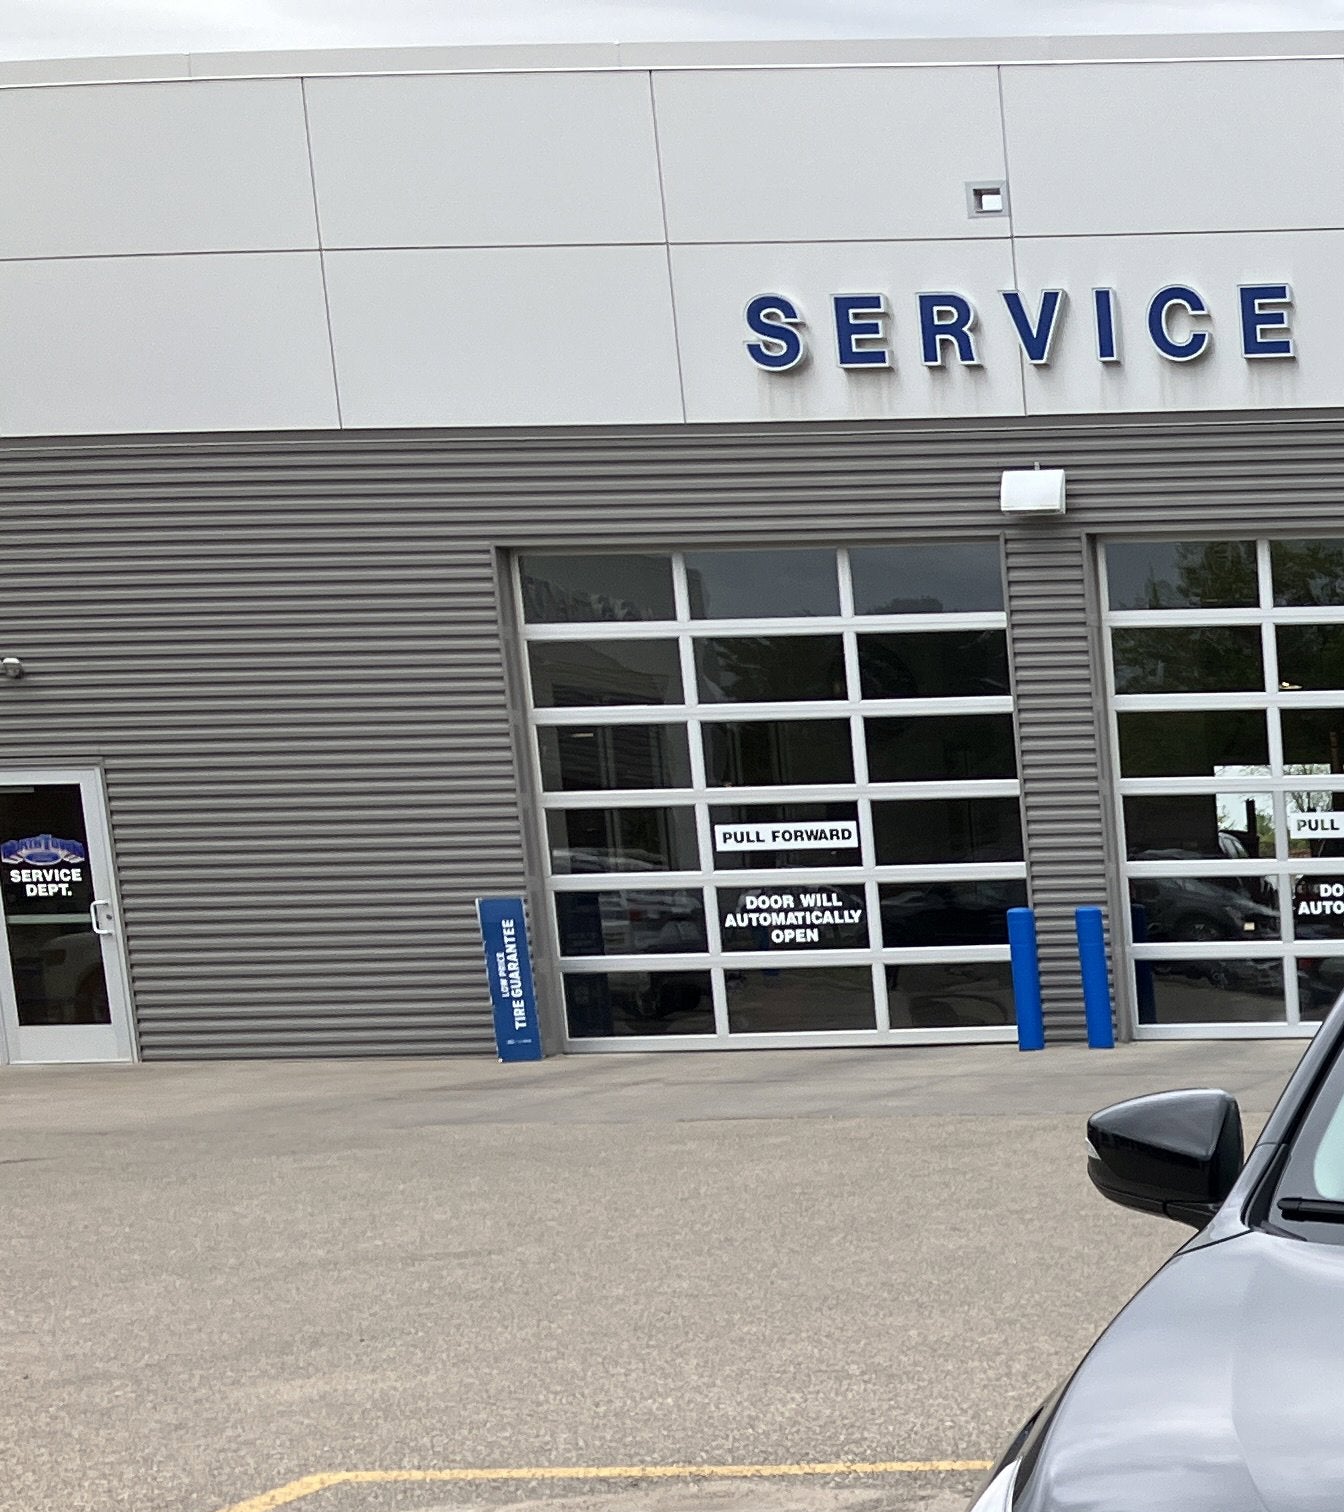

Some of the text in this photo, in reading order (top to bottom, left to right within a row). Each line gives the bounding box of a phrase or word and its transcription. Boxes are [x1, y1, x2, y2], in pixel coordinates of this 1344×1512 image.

[743, 282, 1297, 372] SERVICE
[1297, 819, 1340, 832] PULL
[722, 828, 852, 844] PULL FORWARD
[10, 868, 82, 883] SERVICE
[25, 883, 73, 897] DEPT.
[745, 893, 843, 910] DOOR WILL
[725, 910, 862, 928] AUTOMATICALLY
[771, 928, 819, 944] OPEN
[502, 918, 523, 998] GUARANTEE
[512, 1000, 526, 1031] TIRE
